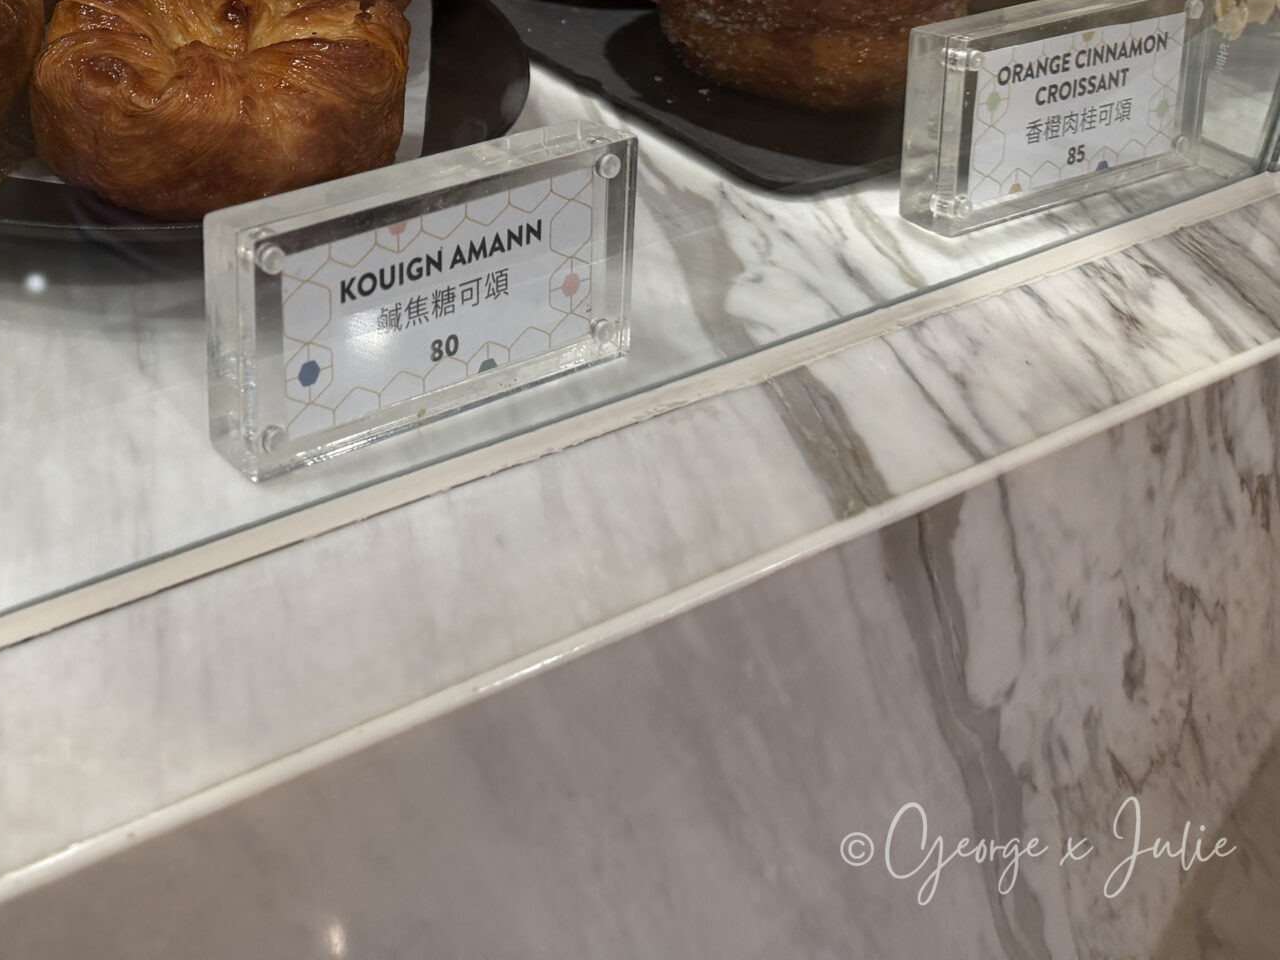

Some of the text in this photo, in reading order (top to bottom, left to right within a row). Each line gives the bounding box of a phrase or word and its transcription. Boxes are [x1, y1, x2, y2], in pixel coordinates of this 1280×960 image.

[996, 31, 1169, 86] ORANGE CINNAMON
[1034, 67, 1131, 107] CROISSANT
[1024, 97, 1133, 145] 香橙肉桂可頌
[1066, 144, 1086, 166] 85
[339, 218, 543, 305] KOUIGN AMANN
[376, 267, 510, 335] 鹹焦糖可頌
[430, 333, 460, 363] 80
